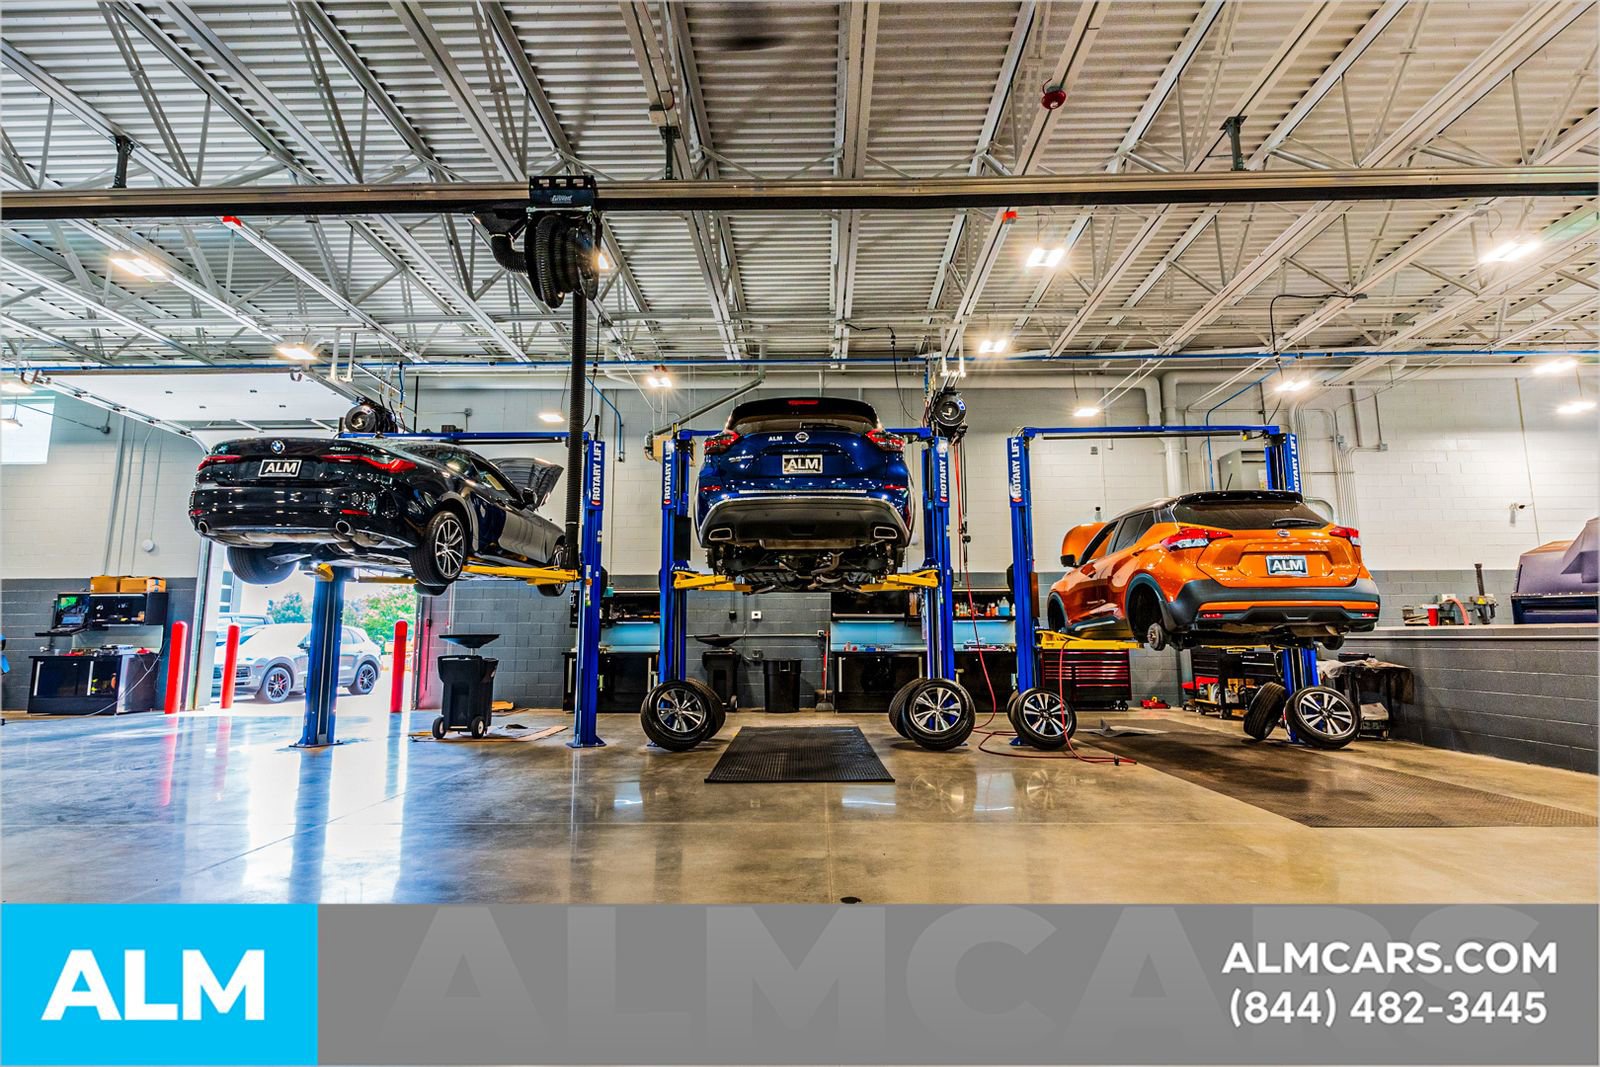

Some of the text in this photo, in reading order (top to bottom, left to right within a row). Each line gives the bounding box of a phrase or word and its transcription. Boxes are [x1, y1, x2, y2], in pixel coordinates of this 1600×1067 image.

[1011, 438, 1020, 458] LIFT
[264, 462, 298, 473] ALM
[592, 441, 602, 500] ROTARY LIFT
[788, 459, 819, 469] ALM
[664, 463, 672, 499] ROTARY
[939, 459, 948, 497] ROTARY
[1272, 560, 1304, 571] ALM
